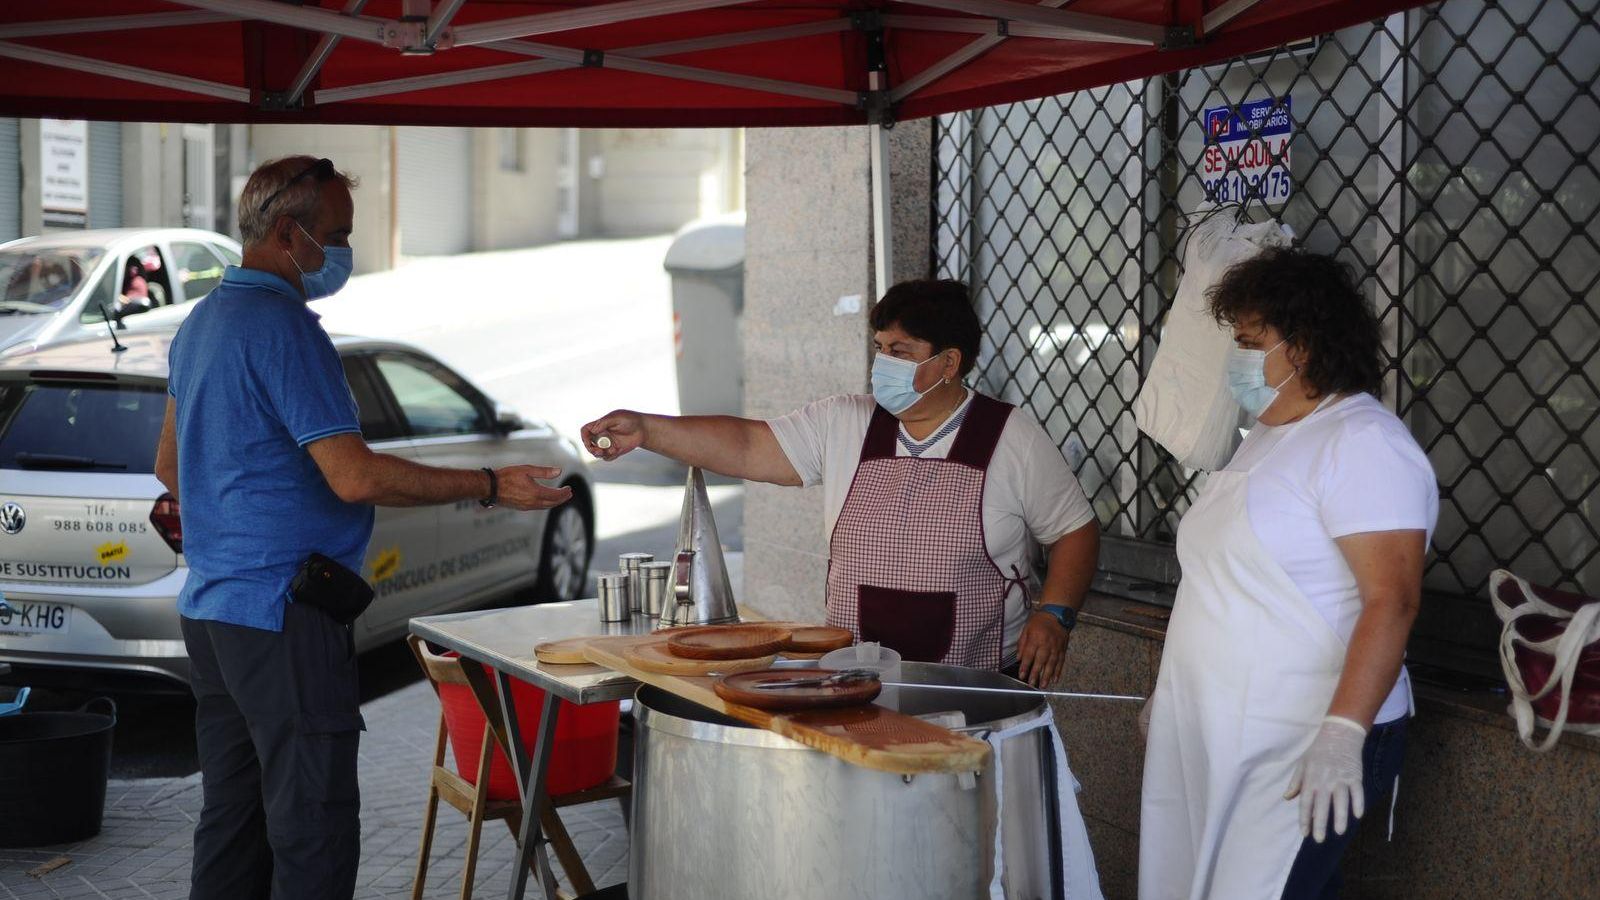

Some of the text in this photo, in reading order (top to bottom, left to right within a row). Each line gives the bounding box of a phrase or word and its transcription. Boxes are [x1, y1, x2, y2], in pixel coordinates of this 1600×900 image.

[1251, 104, 1288, 119] SERVIO
[1236, 115, 1288, 132] INOBIARIOS
[1205, 138, 1289, 173] SE ALQUILA
[54, 520, 147, 533] 988 608 085
[17, 563, 131, 579] SUSTITUCION
[21, 604, 64, 629] KHG
